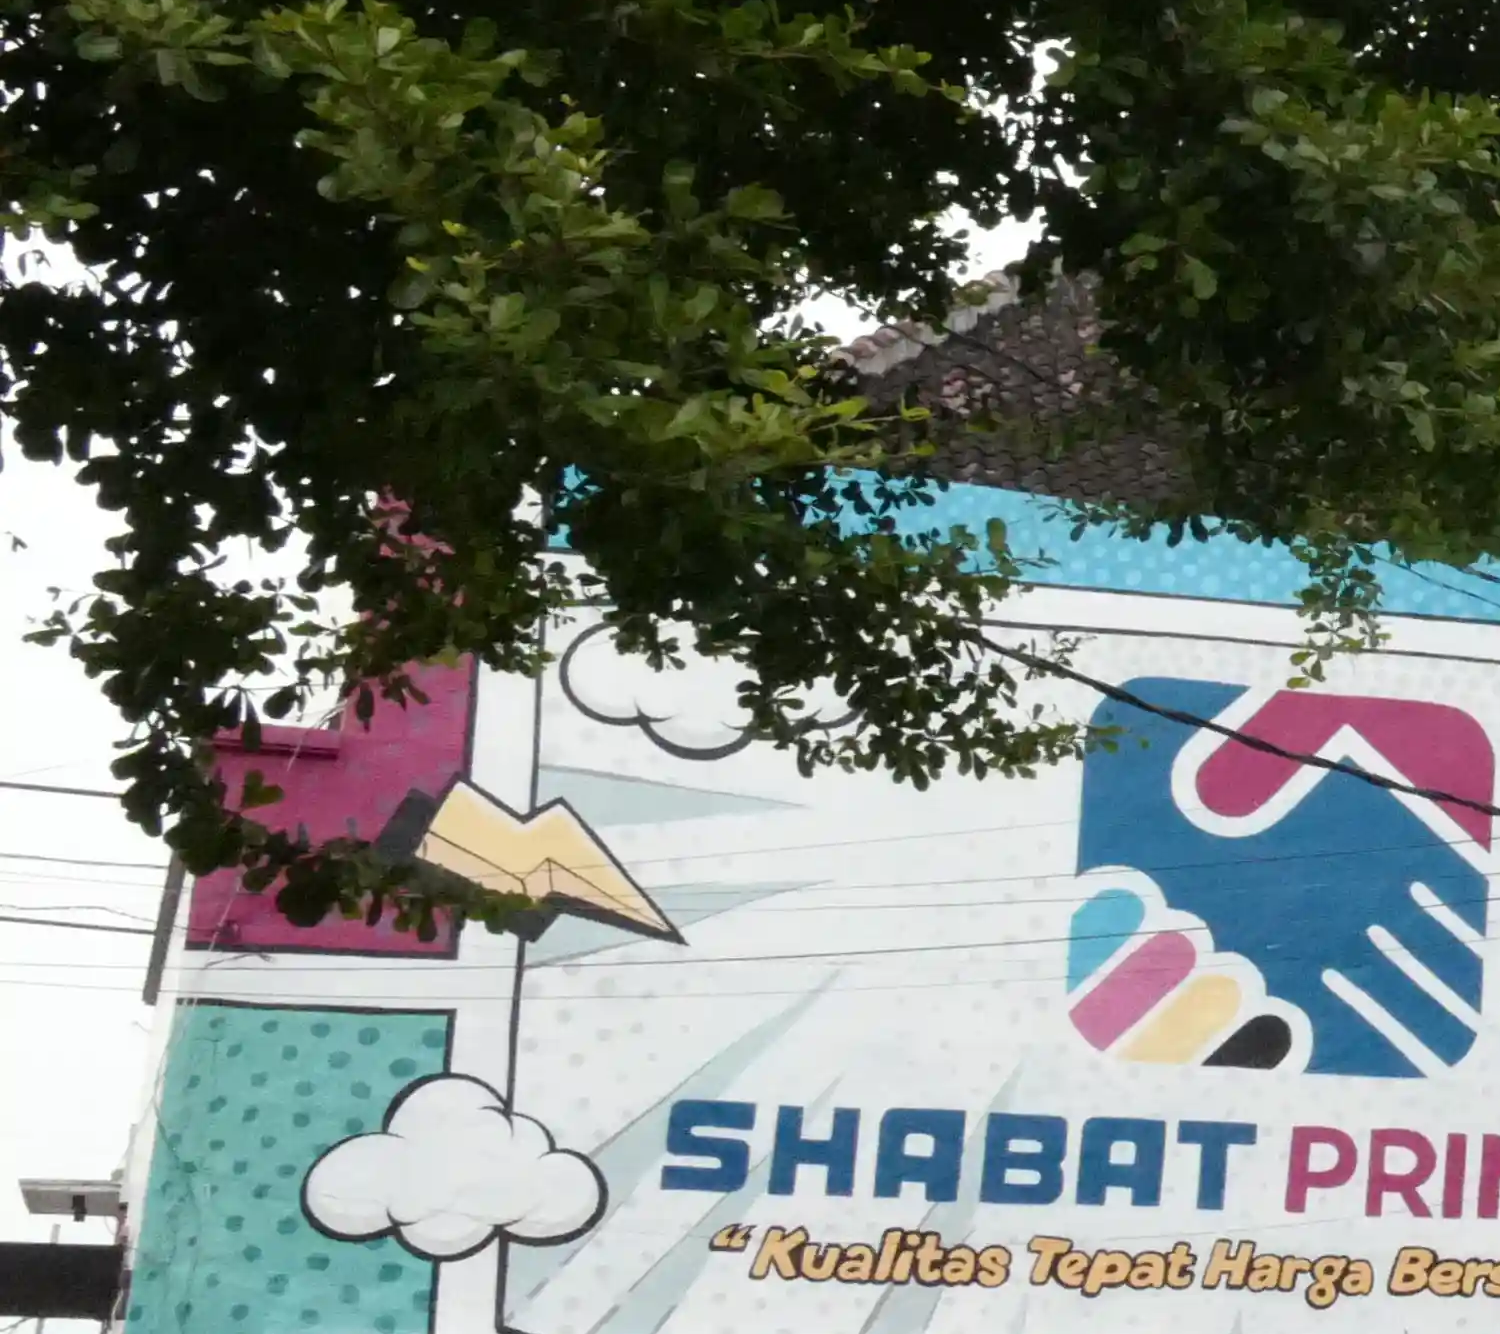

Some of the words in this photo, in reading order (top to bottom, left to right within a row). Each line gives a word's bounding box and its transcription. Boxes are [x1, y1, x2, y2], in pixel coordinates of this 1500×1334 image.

[661, 1099, 1255, 1212] SHABAT
[1027, 1236, 1197, 1293] Tepat
[1201, 1239, 1373, 1308] Harga
